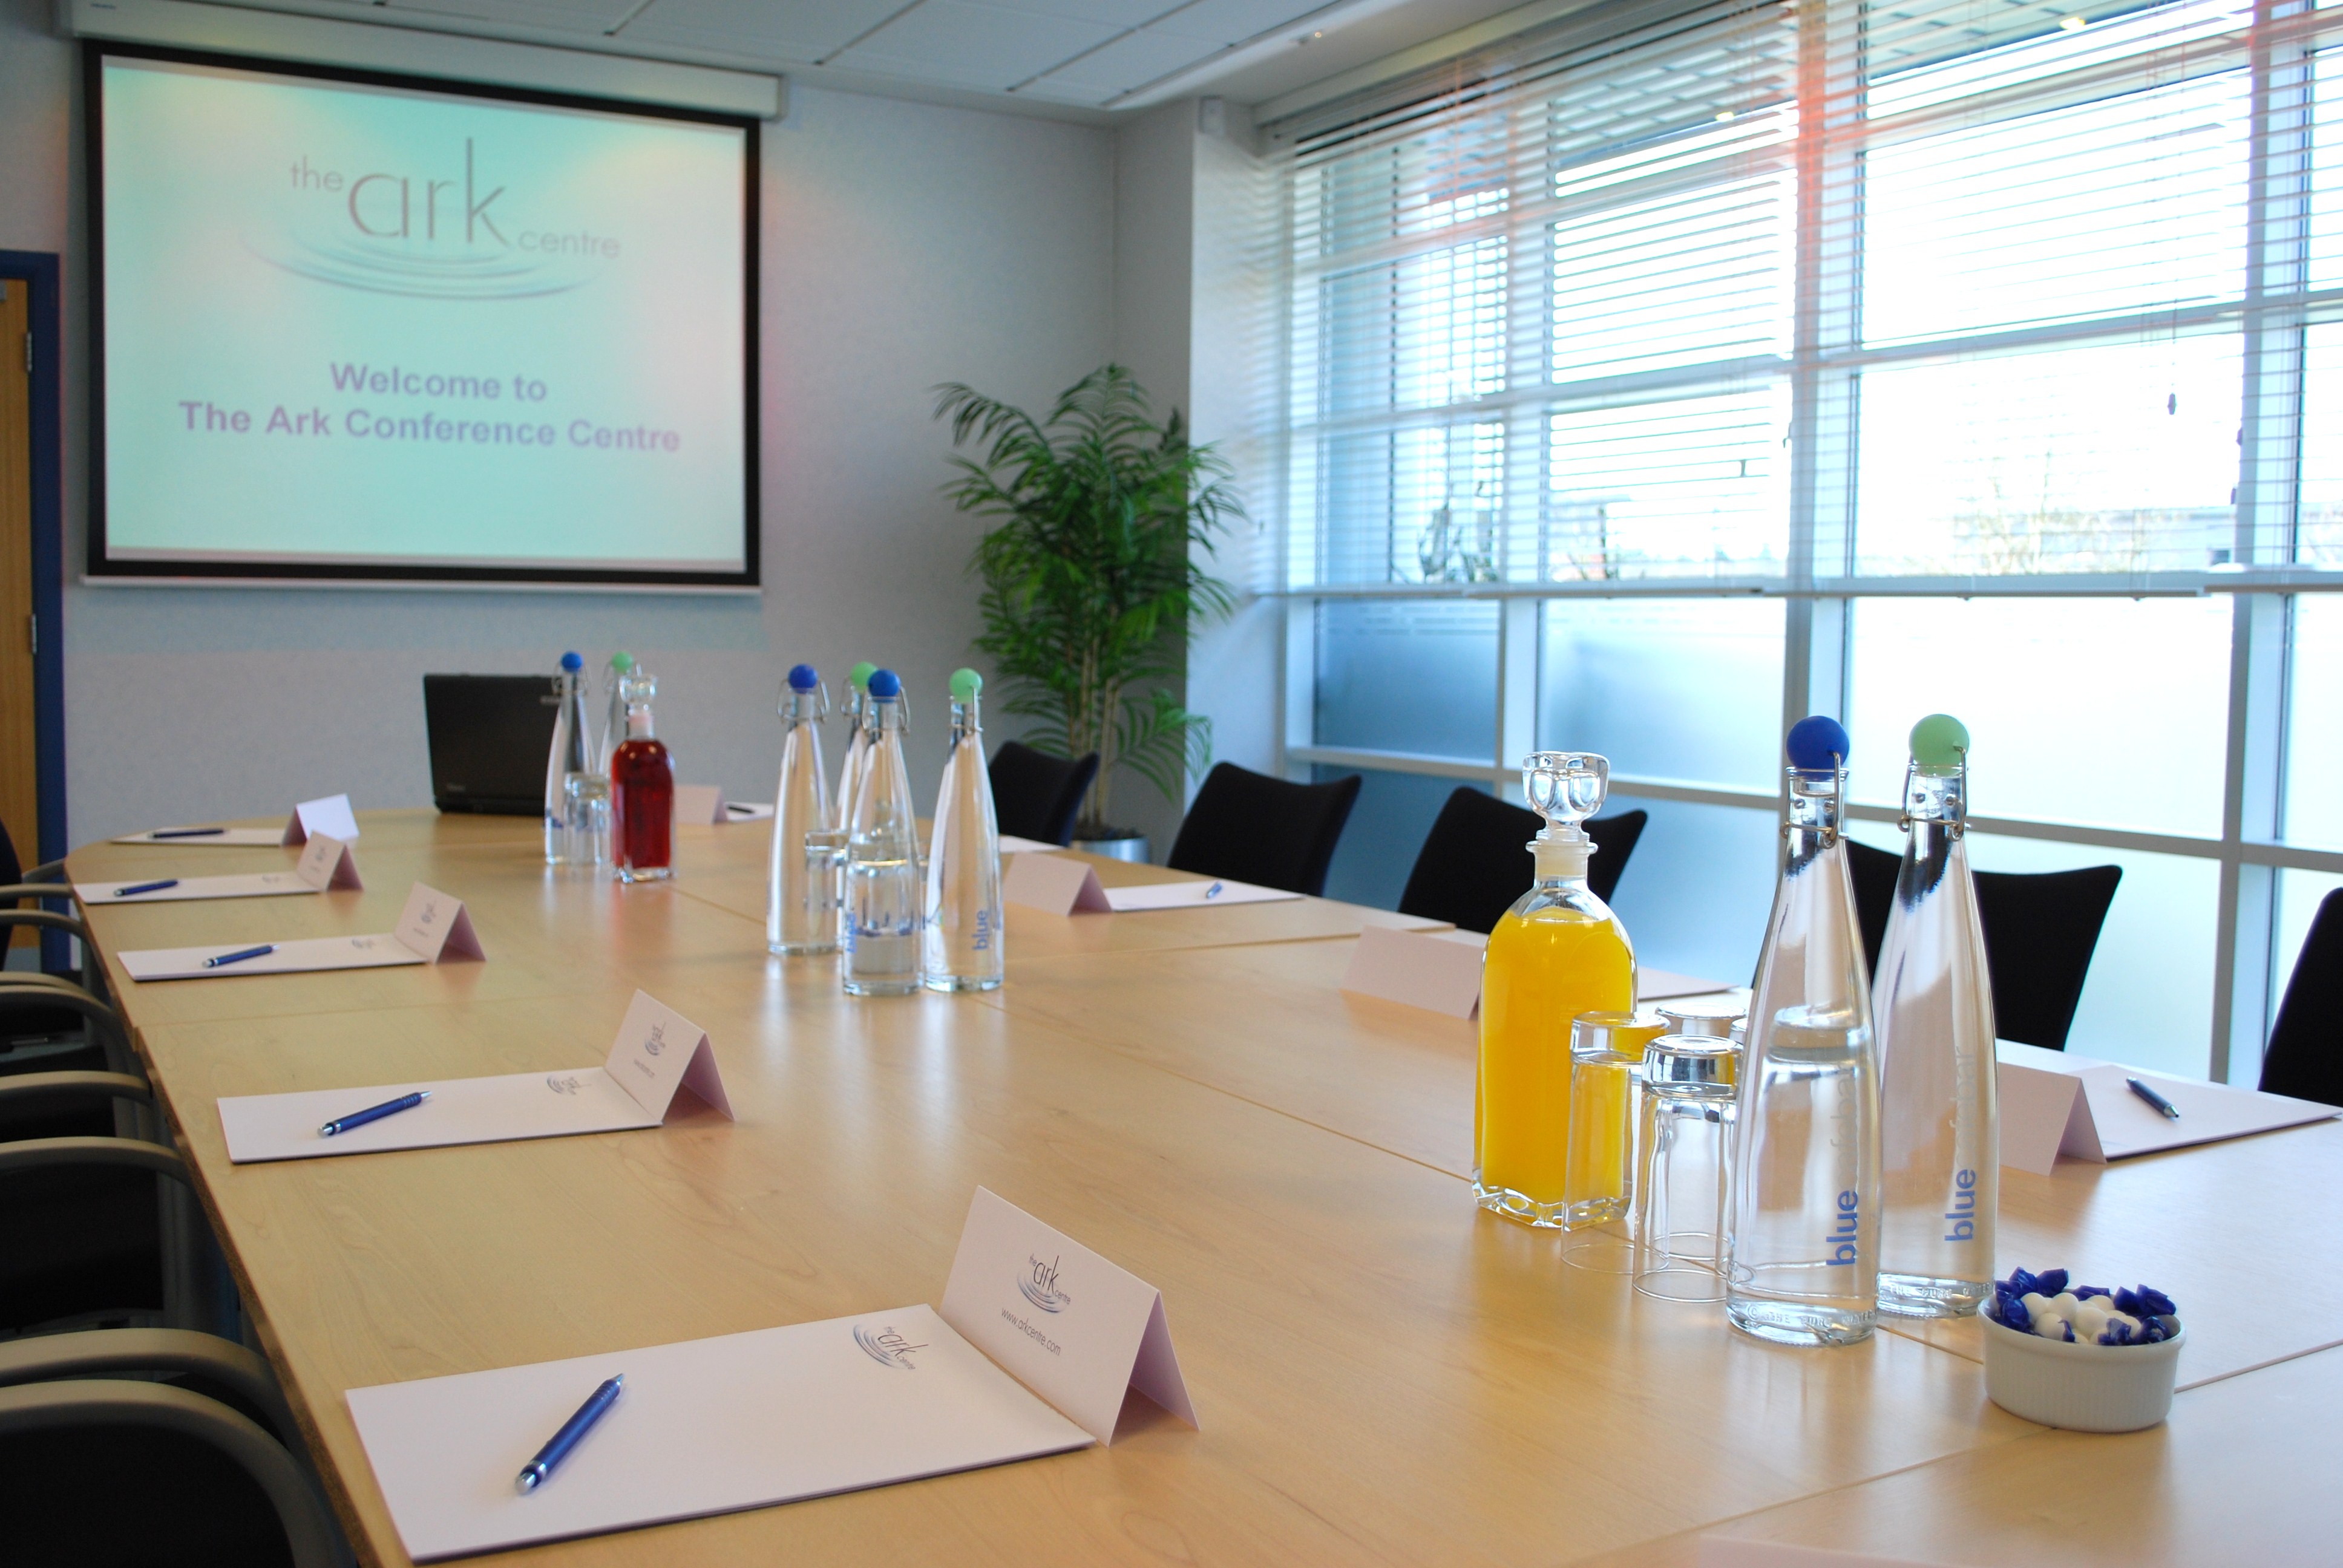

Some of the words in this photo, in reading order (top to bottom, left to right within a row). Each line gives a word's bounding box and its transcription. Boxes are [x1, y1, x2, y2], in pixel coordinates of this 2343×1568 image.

[290, 154, 343, 192] the
[347, 137, 510, 247] ark
[517, 229, 621, 260] centre
[330, 362, 501, 399] Welcome
[513, 373, 547, 402] to
[179, 400, 251, 433] The
[265, 405, 331, 436] Ark
[345, 408, 556, 446] Conference
[568, 419, 680, 452] Centre
[972, 909, 989, 951] blue
[1826, 1189, 1858, 1266] blue
[1944, 1168, 1976, 1242] blue
[1034, 1255, 1060, 1295] ark
[1054, 1289, 1071, 1305] centre
[877, 1334, 929, 1357] ark
[1001, 1307, 1061, 1356] www.arkcentre.com
